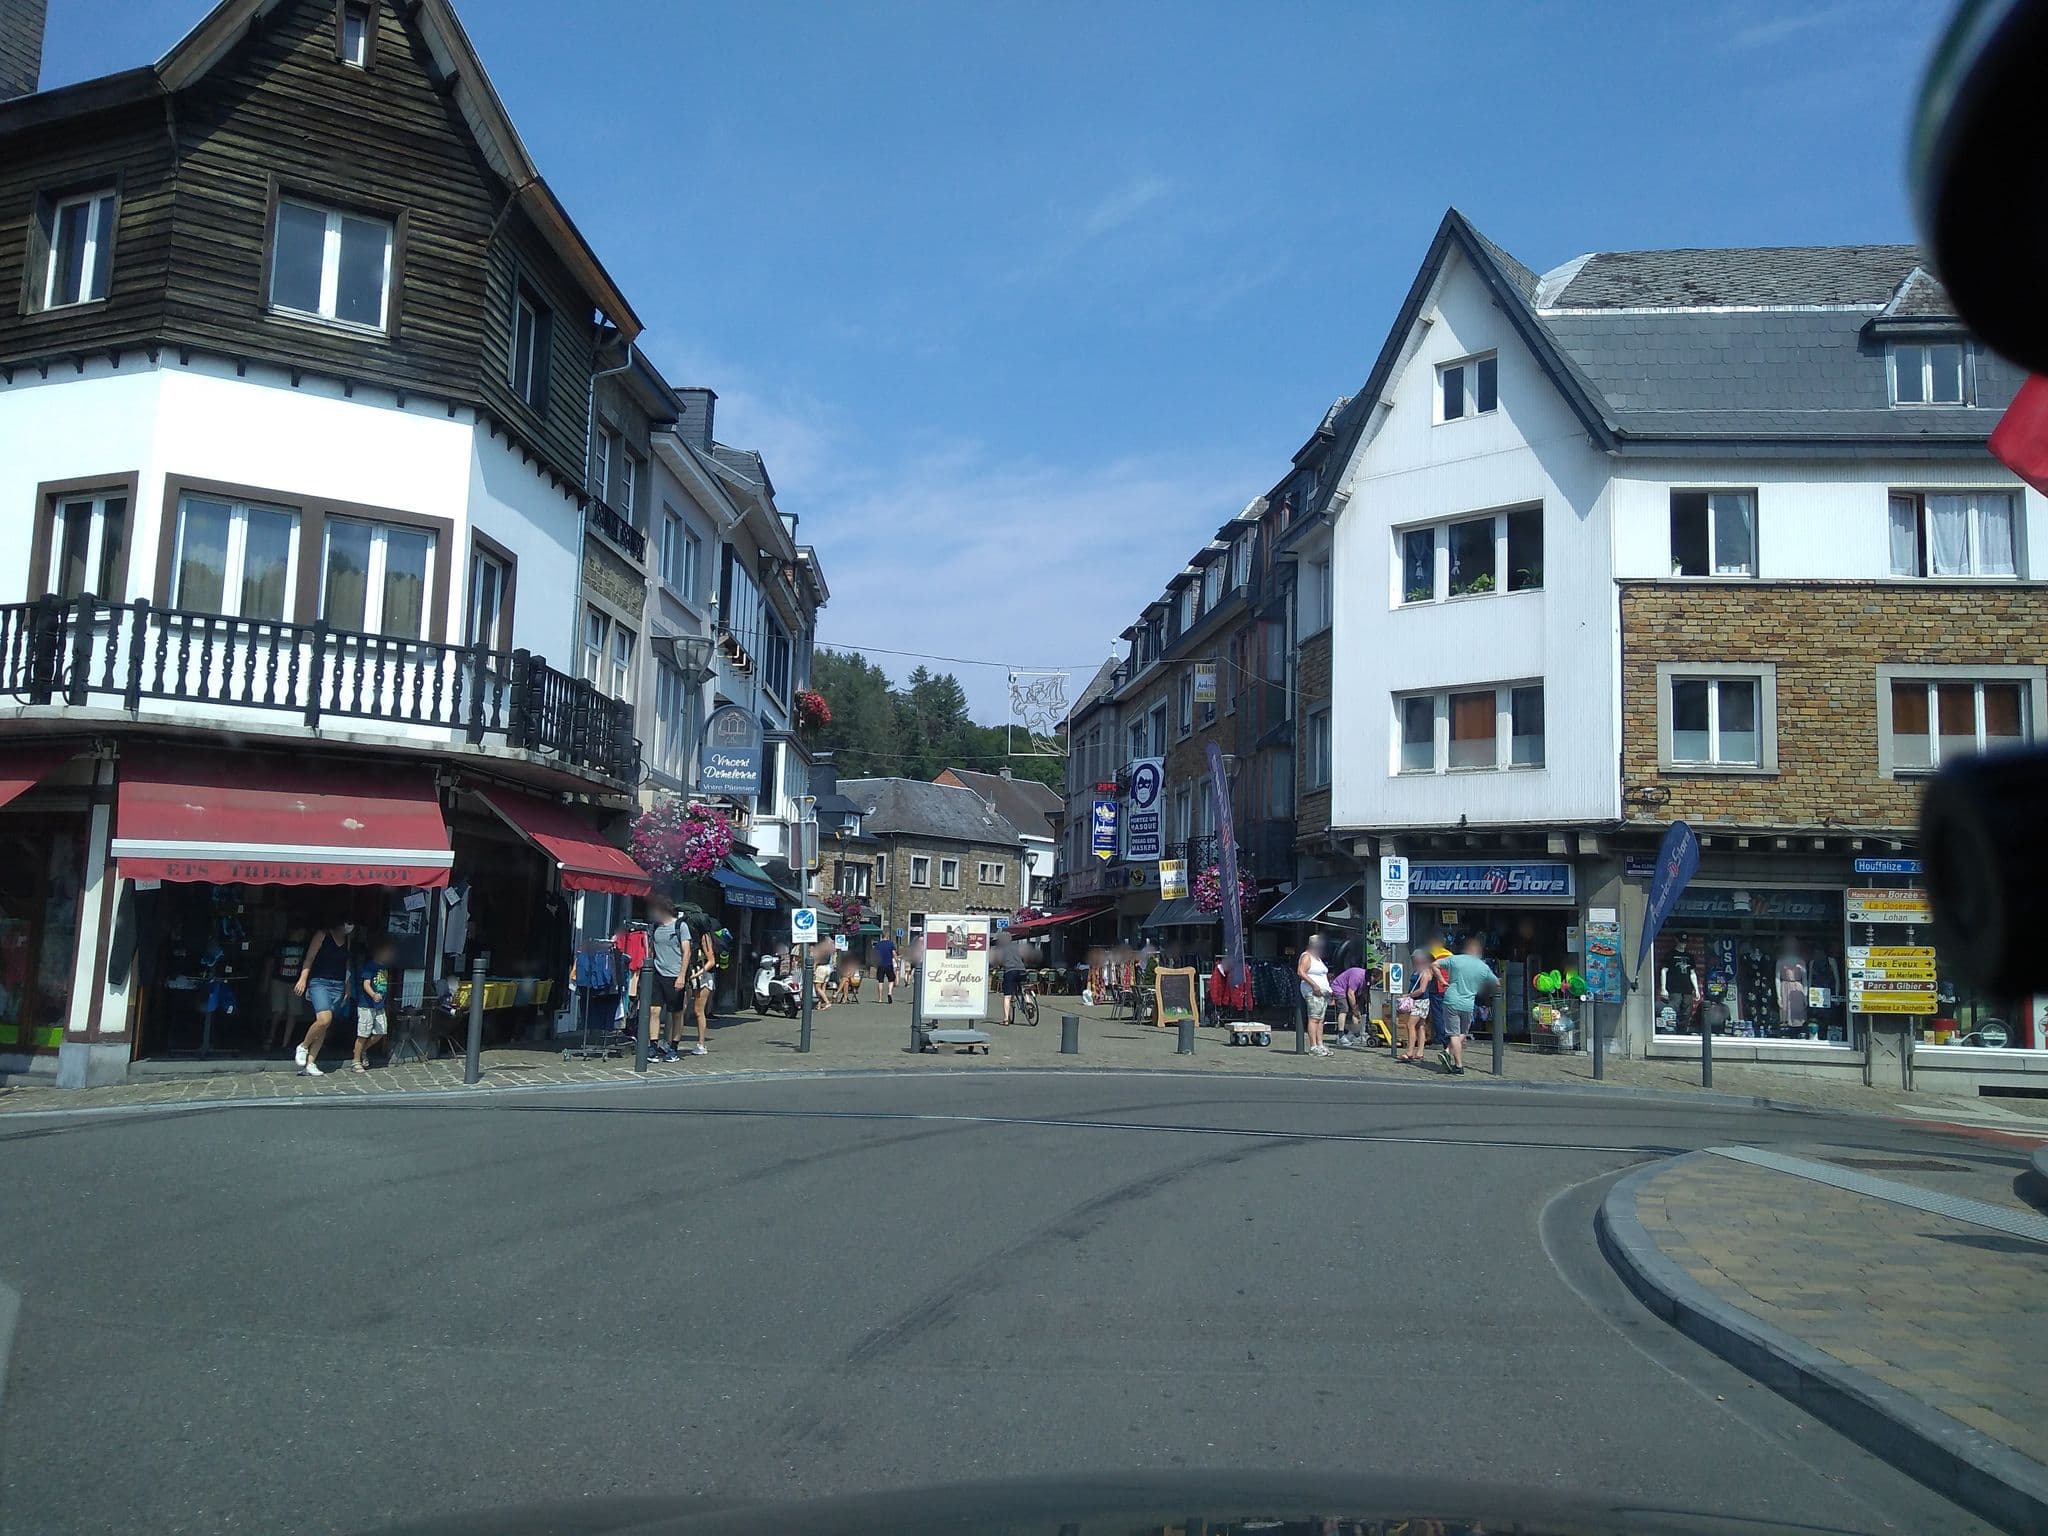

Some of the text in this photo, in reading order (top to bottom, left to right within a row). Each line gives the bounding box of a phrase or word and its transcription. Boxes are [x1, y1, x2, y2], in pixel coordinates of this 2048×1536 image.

[711, 753, 750, 767] Vincent
[166, 863, 209, 876] ETS
[1859, 861, 1902, 871] Houffalize
[1408, 870, 1492, 891] American
[1507, 869, 1564, 891] Store
[1851, 891, 1876, 899] Hameau
[1883, 913, 1908, 921] Lohan
[1722, 940, 1734, 975] USA
[1872, 960, 1918, 969] Les Eveux
[928, 970, 983, 986] L'Apéro
[1868, 982, 1922, 990] Parc à Gibier
